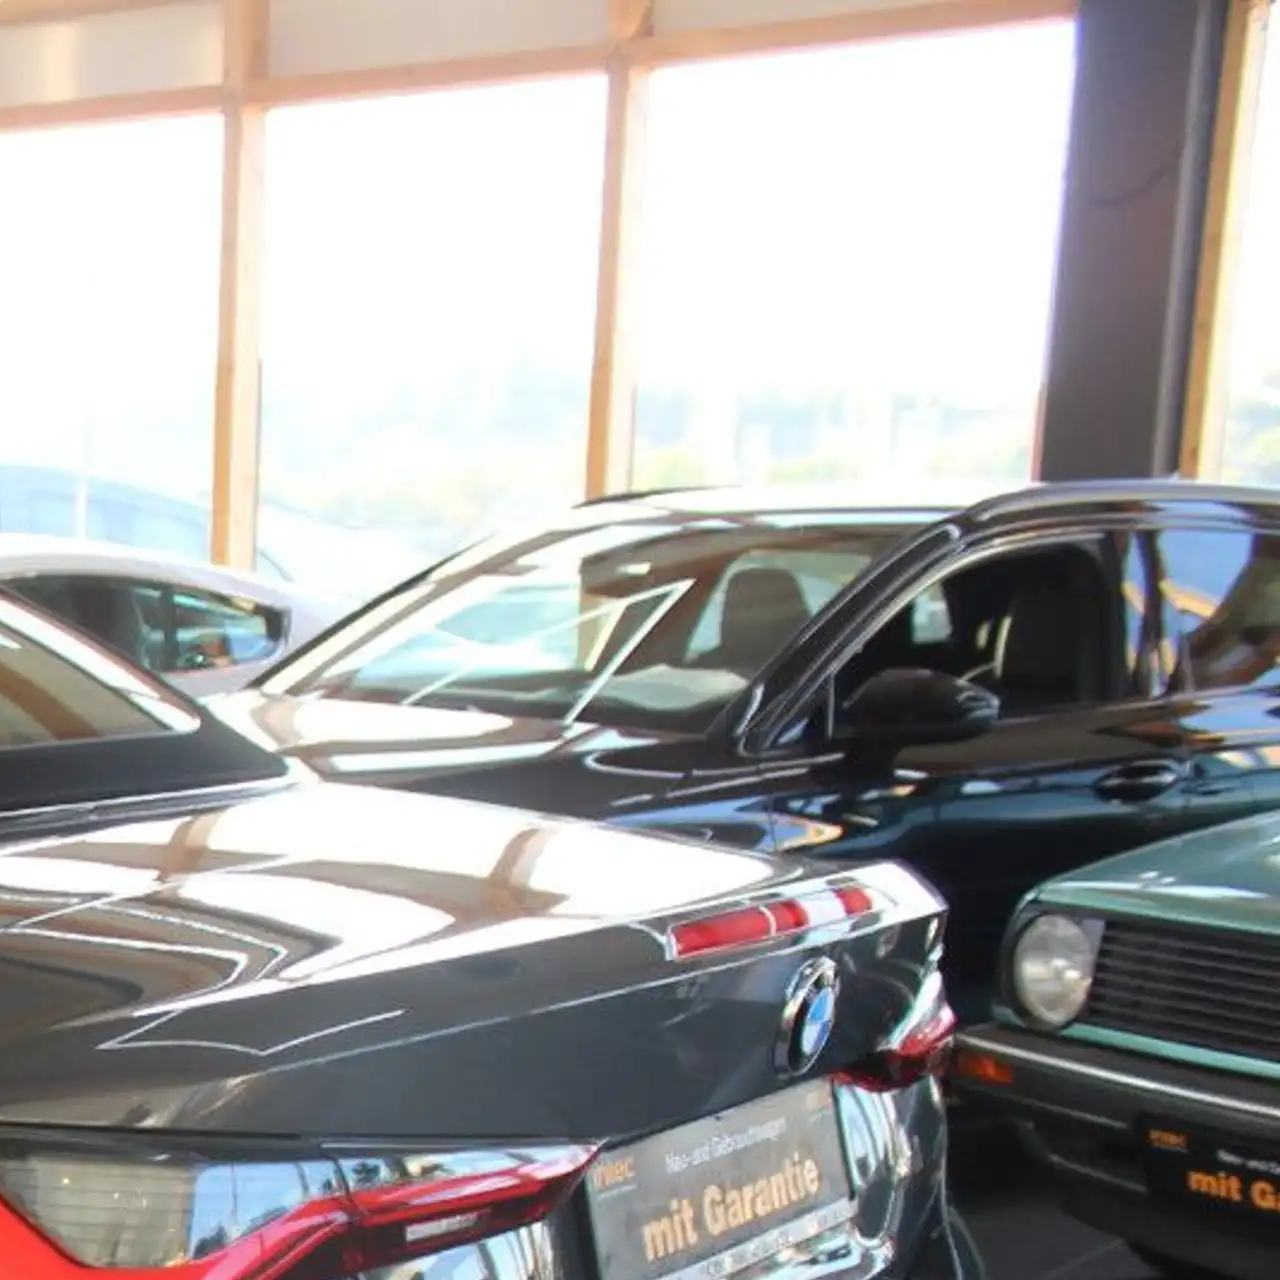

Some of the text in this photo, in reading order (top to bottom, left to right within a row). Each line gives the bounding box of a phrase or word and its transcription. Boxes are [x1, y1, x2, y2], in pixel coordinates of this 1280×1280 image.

[642, 1197, 699, 1263] mit
[702, 1151, 822, 1237] Garantie
[1187, 1170, 1280, 1211] mit G
